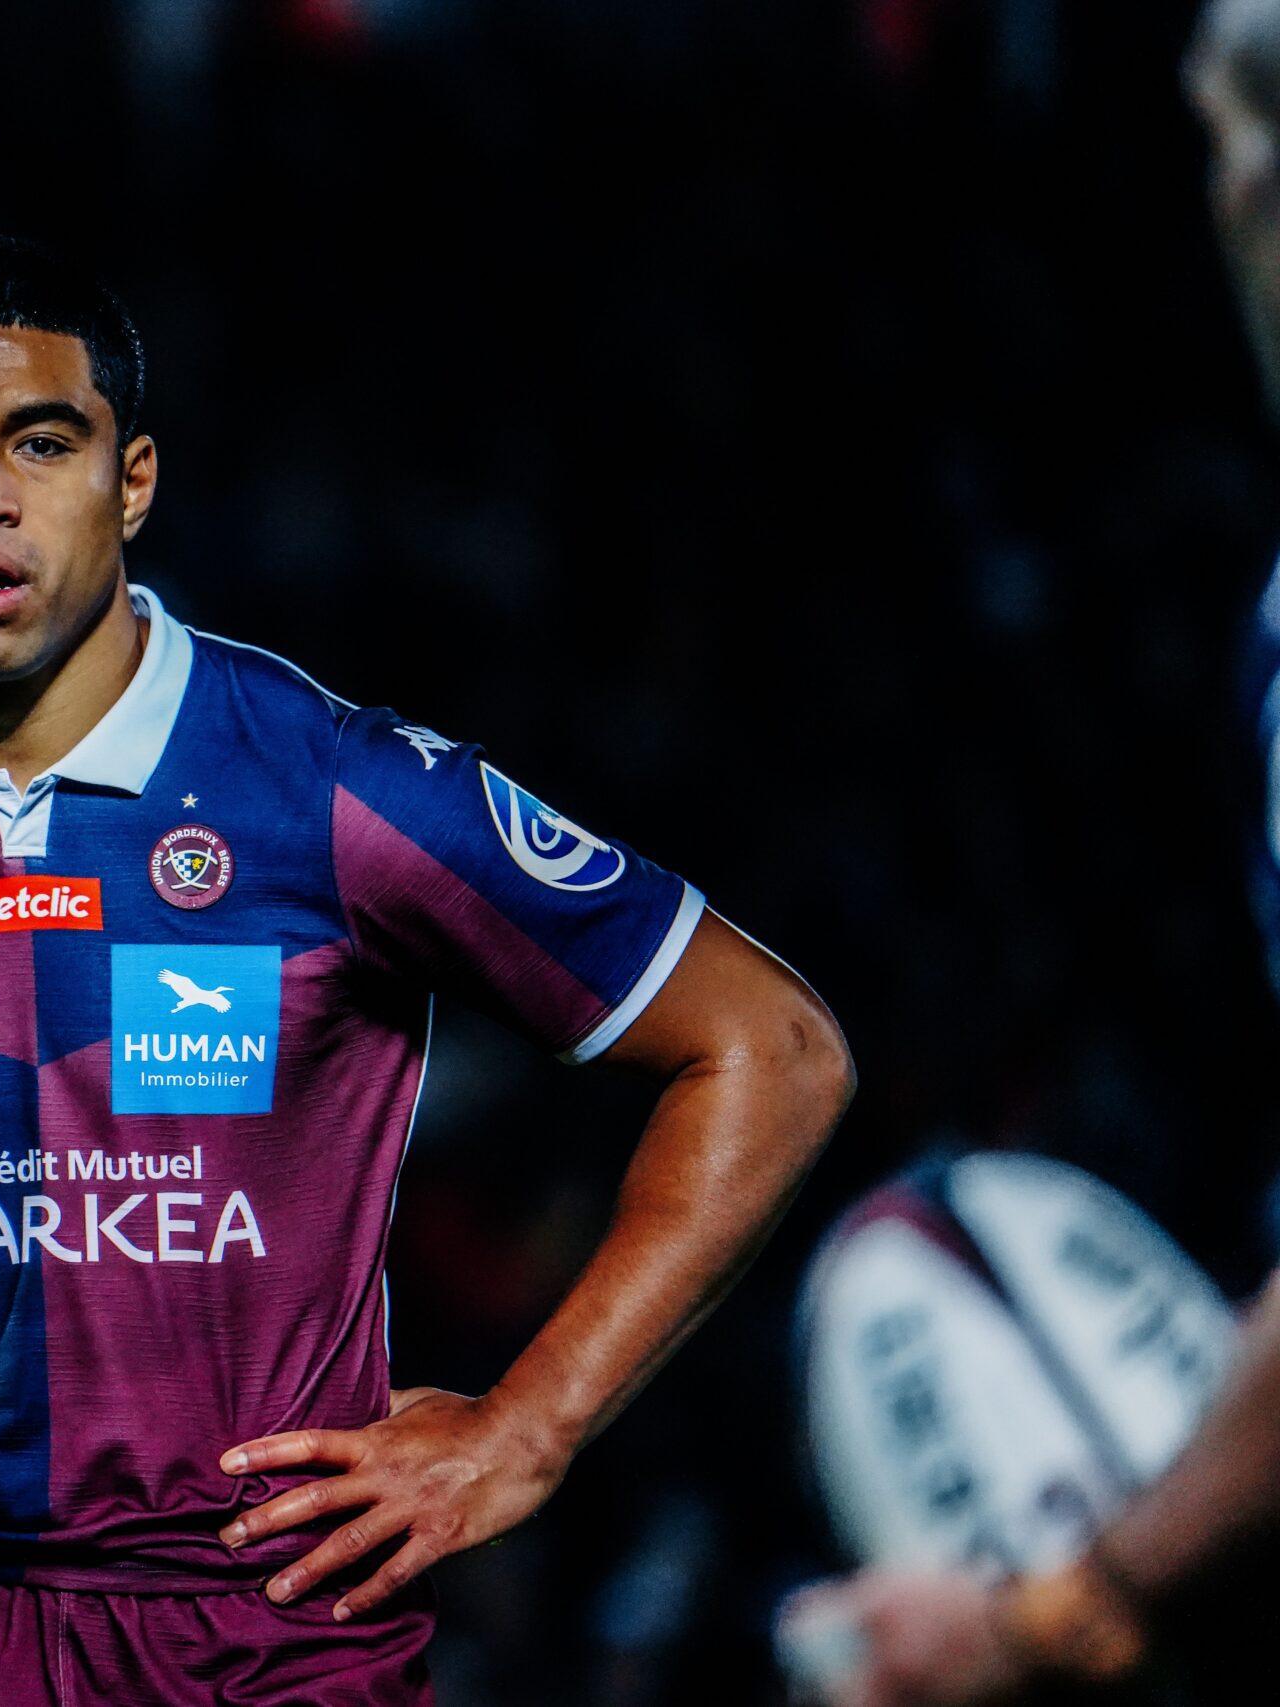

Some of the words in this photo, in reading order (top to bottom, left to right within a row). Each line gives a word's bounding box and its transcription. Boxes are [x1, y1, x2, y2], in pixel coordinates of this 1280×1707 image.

[152, 851, 163, 885] UNION
[163, 829, 218, 846] BORDEAUX
[124, 1034, 266, 1063] HUMAN
[140, 1071, 249, 1088] Immobilier
[68, 1145, 202, 1181] Mutuel
